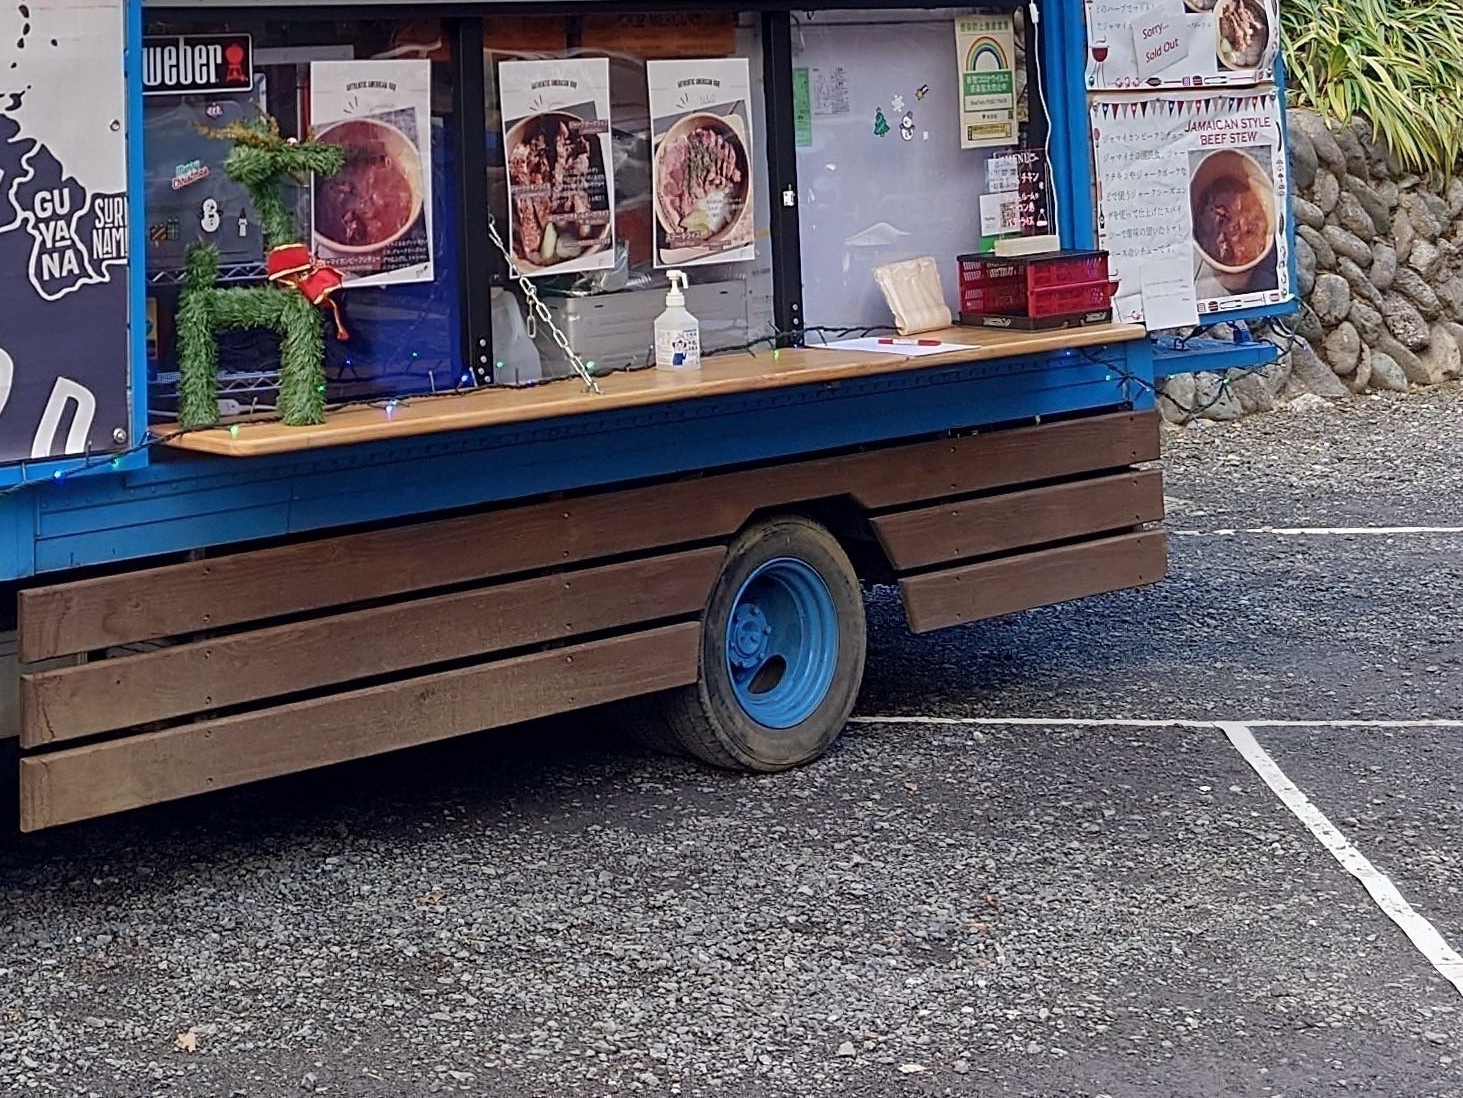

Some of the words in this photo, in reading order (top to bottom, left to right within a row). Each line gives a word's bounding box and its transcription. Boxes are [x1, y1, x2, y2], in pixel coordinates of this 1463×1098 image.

[142, 36, 222, 85] weber
[1145, 48, 1162, 63] Sold
[1162, 38, 1180, 54] Out
[1184, 118, 1238, 133] JAMAICAN
[1240, 116, 1271, 129] STYLE
[1200, 133, 1227, 146] BEEF
[1230, 131, 1258, 144] STEW
[35, 187, 70, 219] GU
[38, 219, 72, 249] YA
[41, 248, 79, 280] NA
